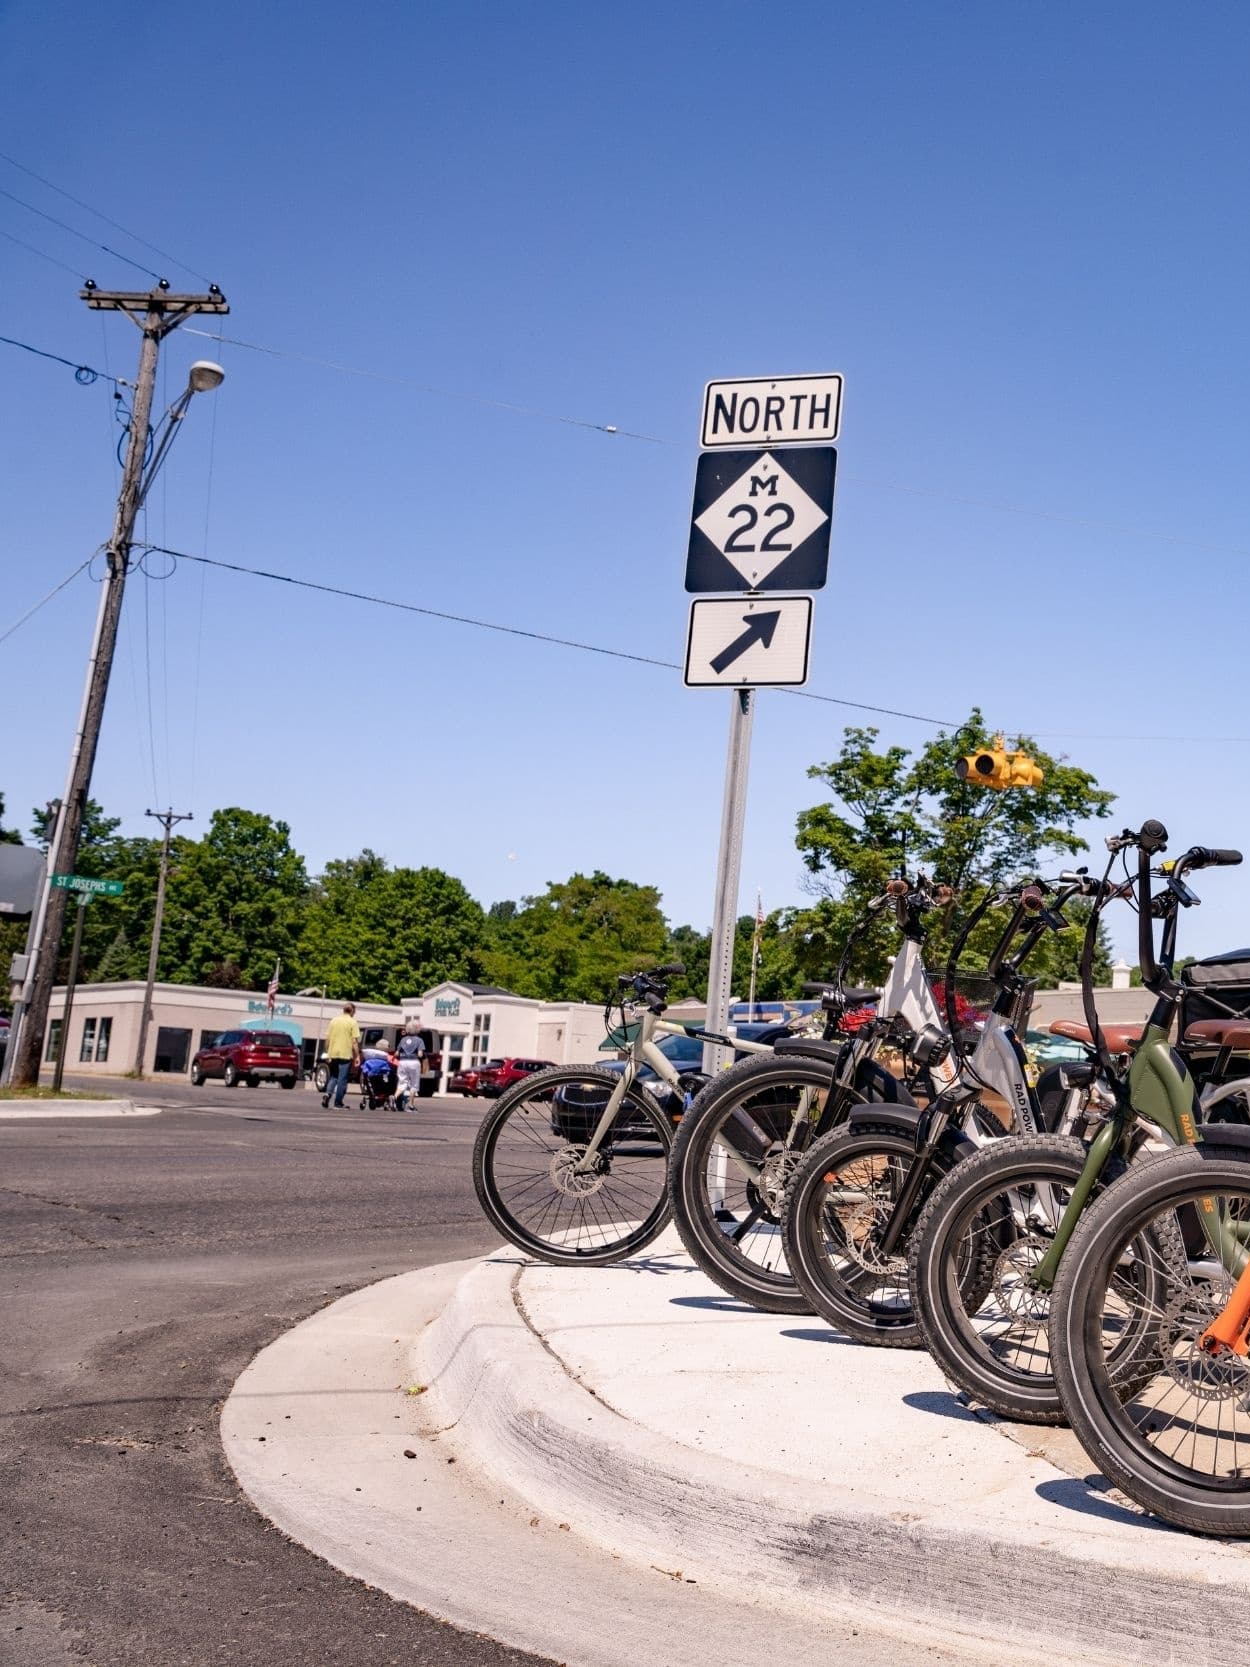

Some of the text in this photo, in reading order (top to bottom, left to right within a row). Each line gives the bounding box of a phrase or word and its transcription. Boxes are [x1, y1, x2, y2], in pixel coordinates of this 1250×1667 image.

[712, 393, 831, 434] NORTH
[749, 475, 779, 497] M
[724, 503, 795, 553] 22
[56, 876, 67, 887] ST
[69, 878, 107, 892] JOSEPHS
[1014, 1083, 1034, 1135] RAD POW
[1180, 1113, 1194, 1138] RAD
